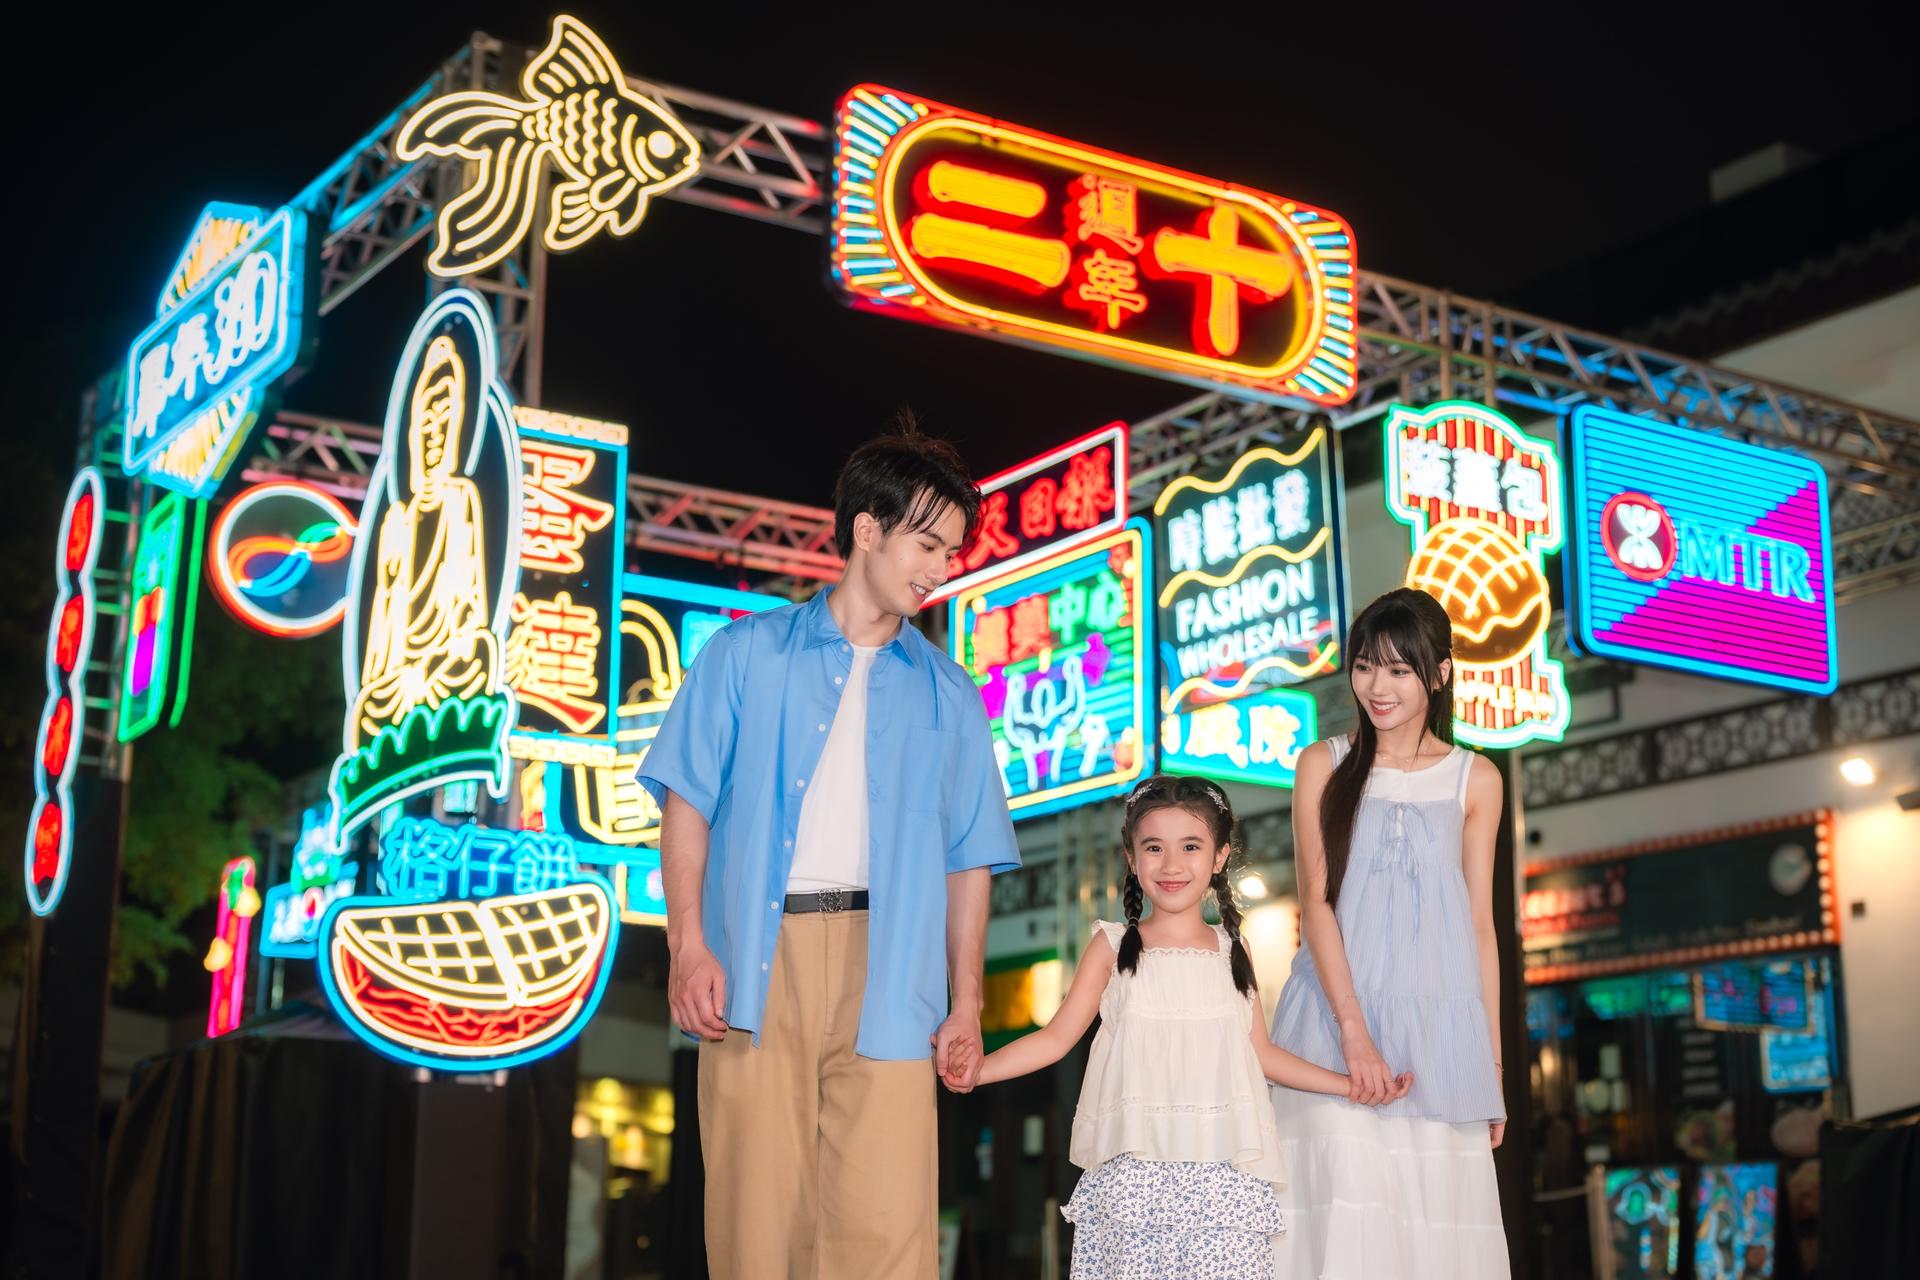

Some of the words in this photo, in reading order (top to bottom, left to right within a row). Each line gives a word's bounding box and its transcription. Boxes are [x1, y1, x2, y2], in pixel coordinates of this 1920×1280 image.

[1679, 518, 1817, 604] MTR
[1175, 559, 1315, 643] FASHION
[1178, 606, 1320, 679] WHOLESALE
[1453, 679, 1515, 710] APPLE
[389, 825, 569, 899] 格仔餅
